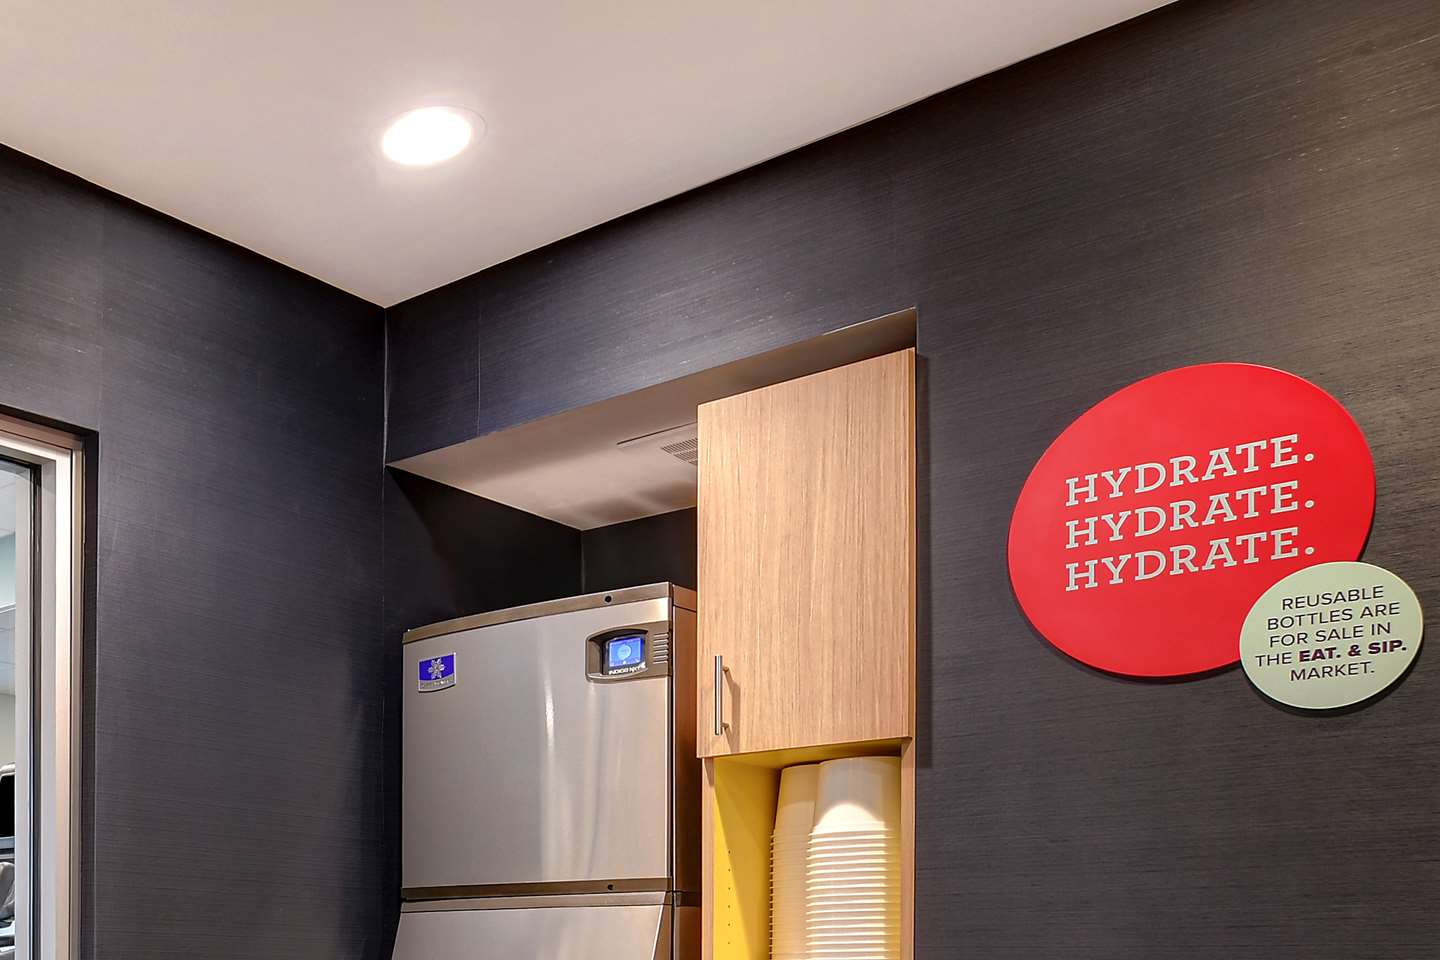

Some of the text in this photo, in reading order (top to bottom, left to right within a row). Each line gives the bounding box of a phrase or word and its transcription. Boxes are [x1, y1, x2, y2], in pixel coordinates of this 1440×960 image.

[1065, 433, 1315, 507] HYDRATE.
[1065, 480, 1315, 549] HYDRATE.
[1065, 526, 1315, 592] HYDRATE.
[1282, 585, 1384, 611] REUSABLE
[1267, 602, 1400, 631] BOTTLES ARE
[1270, 622, 1391, 648] FOR SALE IN
[1255, 640, 1407, 667] THE EAT. & SIP.
[1290, 661, 1375, 682] MARKET.
